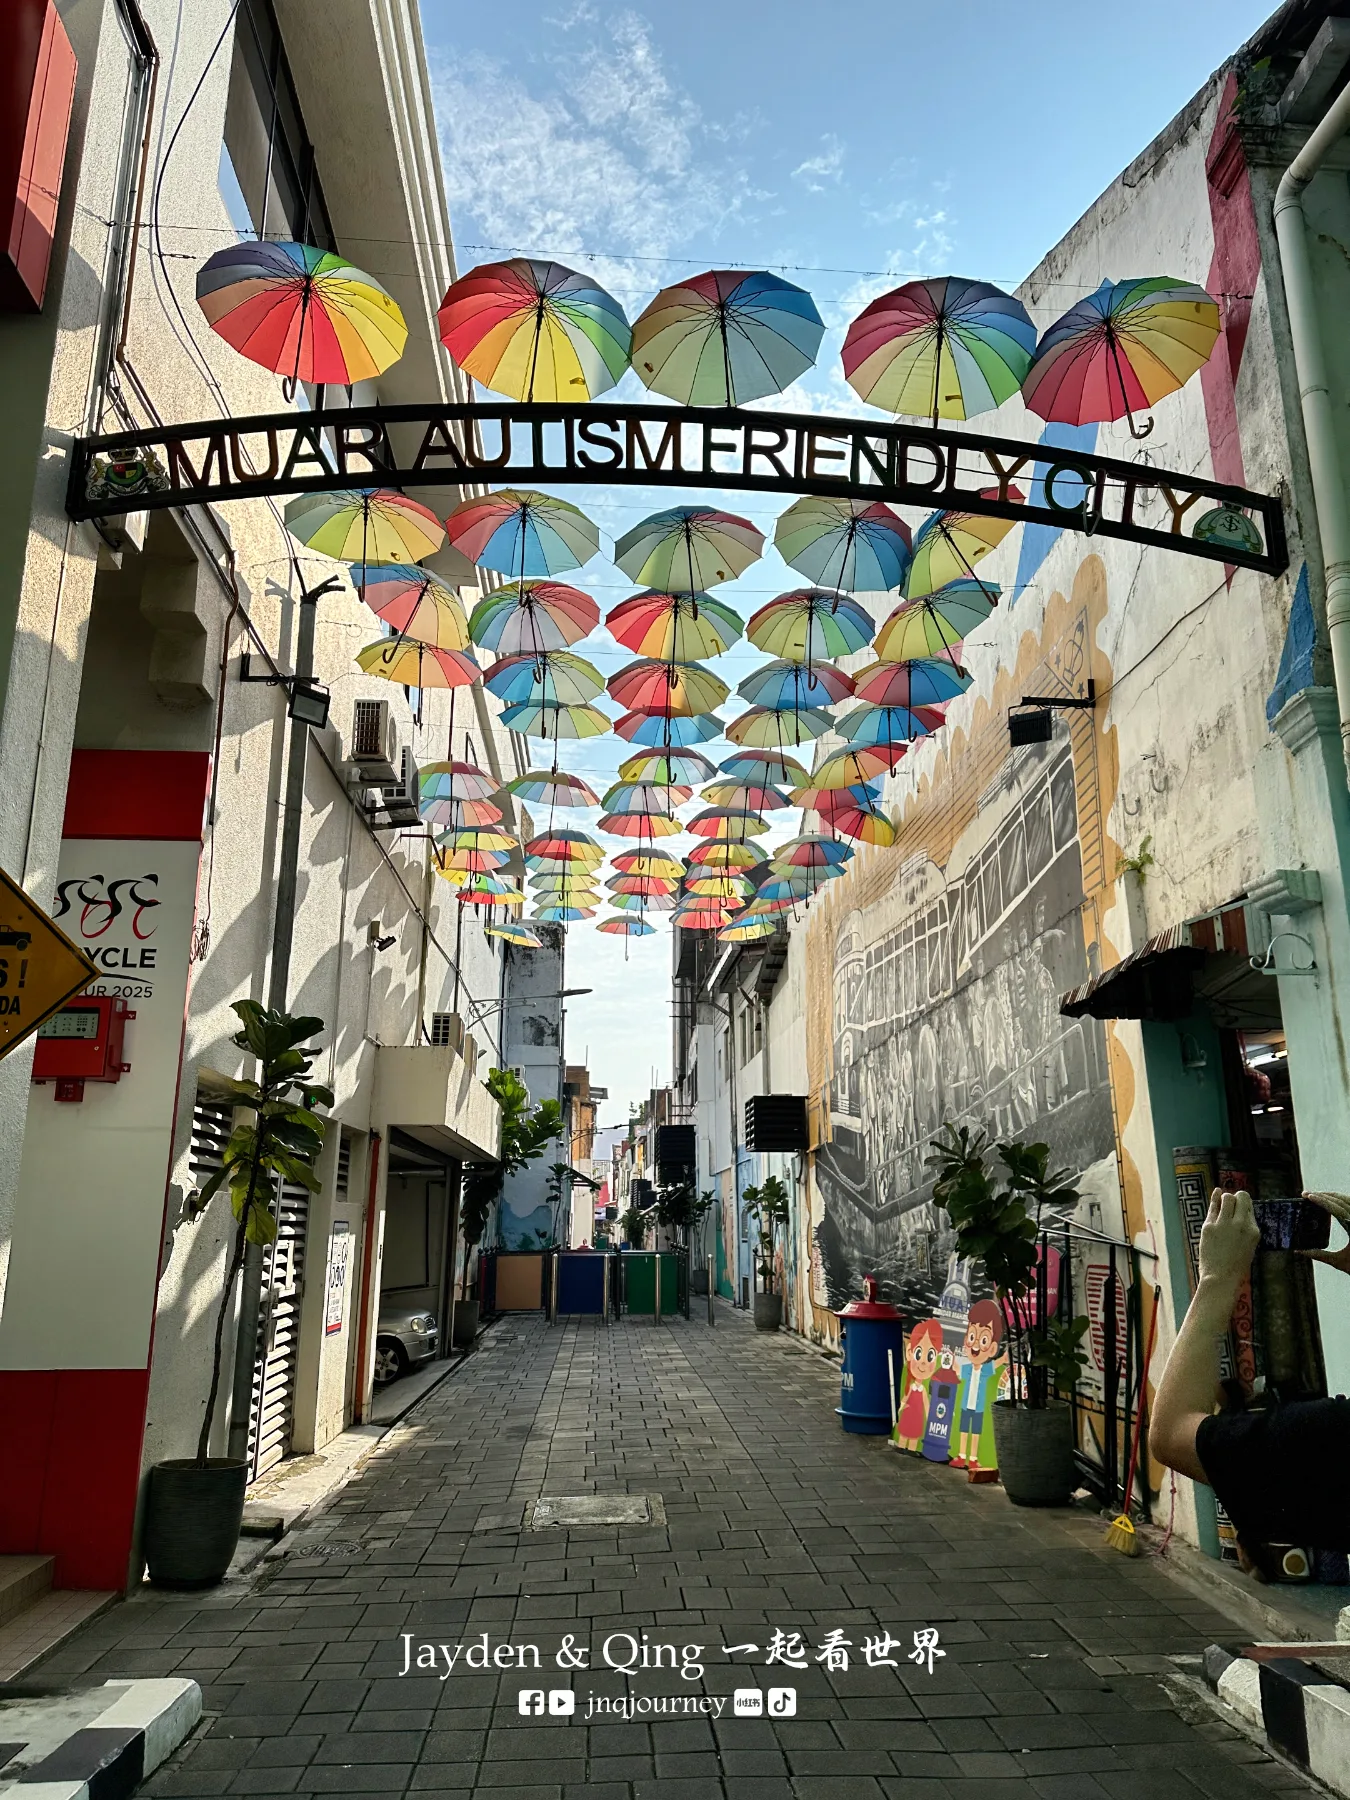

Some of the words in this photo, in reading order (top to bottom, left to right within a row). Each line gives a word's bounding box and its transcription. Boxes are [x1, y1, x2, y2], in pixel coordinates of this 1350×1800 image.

[168, 421, 392, 490] MUAR
[416, 416, 684, 470] AUTISM
[702, 426, 1029, 502] FRIENDLY
[1044, 461, 1203, 536] CITY
[77, 947, 157, 969] YCLE
[113, 985, 153, 998] 2025
[928, 1422, 948, 1436] MPM
